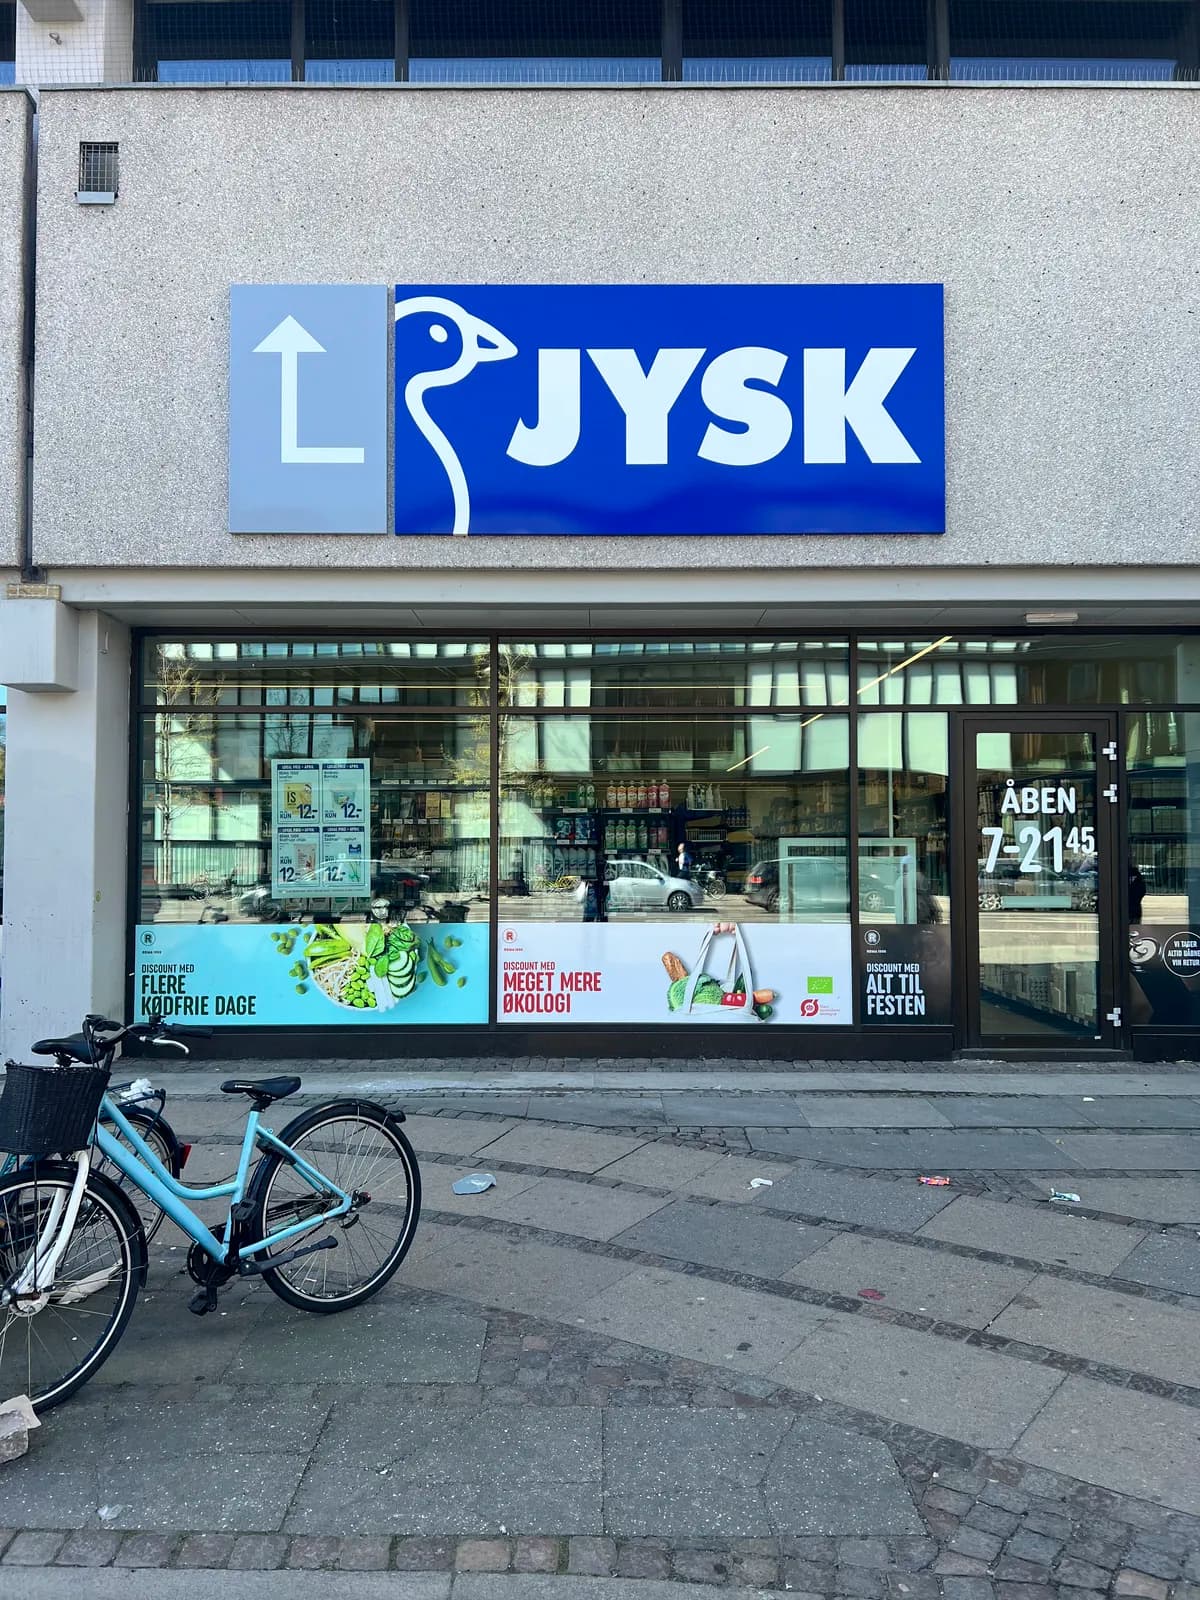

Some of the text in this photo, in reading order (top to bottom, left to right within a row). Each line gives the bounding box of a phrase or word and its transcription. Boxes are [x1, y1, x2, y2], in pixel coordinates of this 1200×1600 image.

[505, 346, 922, 466] JYSK
[287, 791, 297, 804] IS
[1001, 778, 1076, 814] ÅBEN
[141, 964, 195, 973] DISCOUNT MED
[503, 961, 556, 971] DISCOUNT MED
[866, 963, 920, 973] DISCOUNT MED
[141, 974, 186, 995] FLERE
[503, 971, 602, 992] MEGET MERE
[866, 973, 924, 994] ALT TIL
[141, 995, 257, 1016] KØDFRIE DAGE
[503, 992, 571, 1013] ØKOLOGI
[867, 994, 926, 1016] FESTEN
